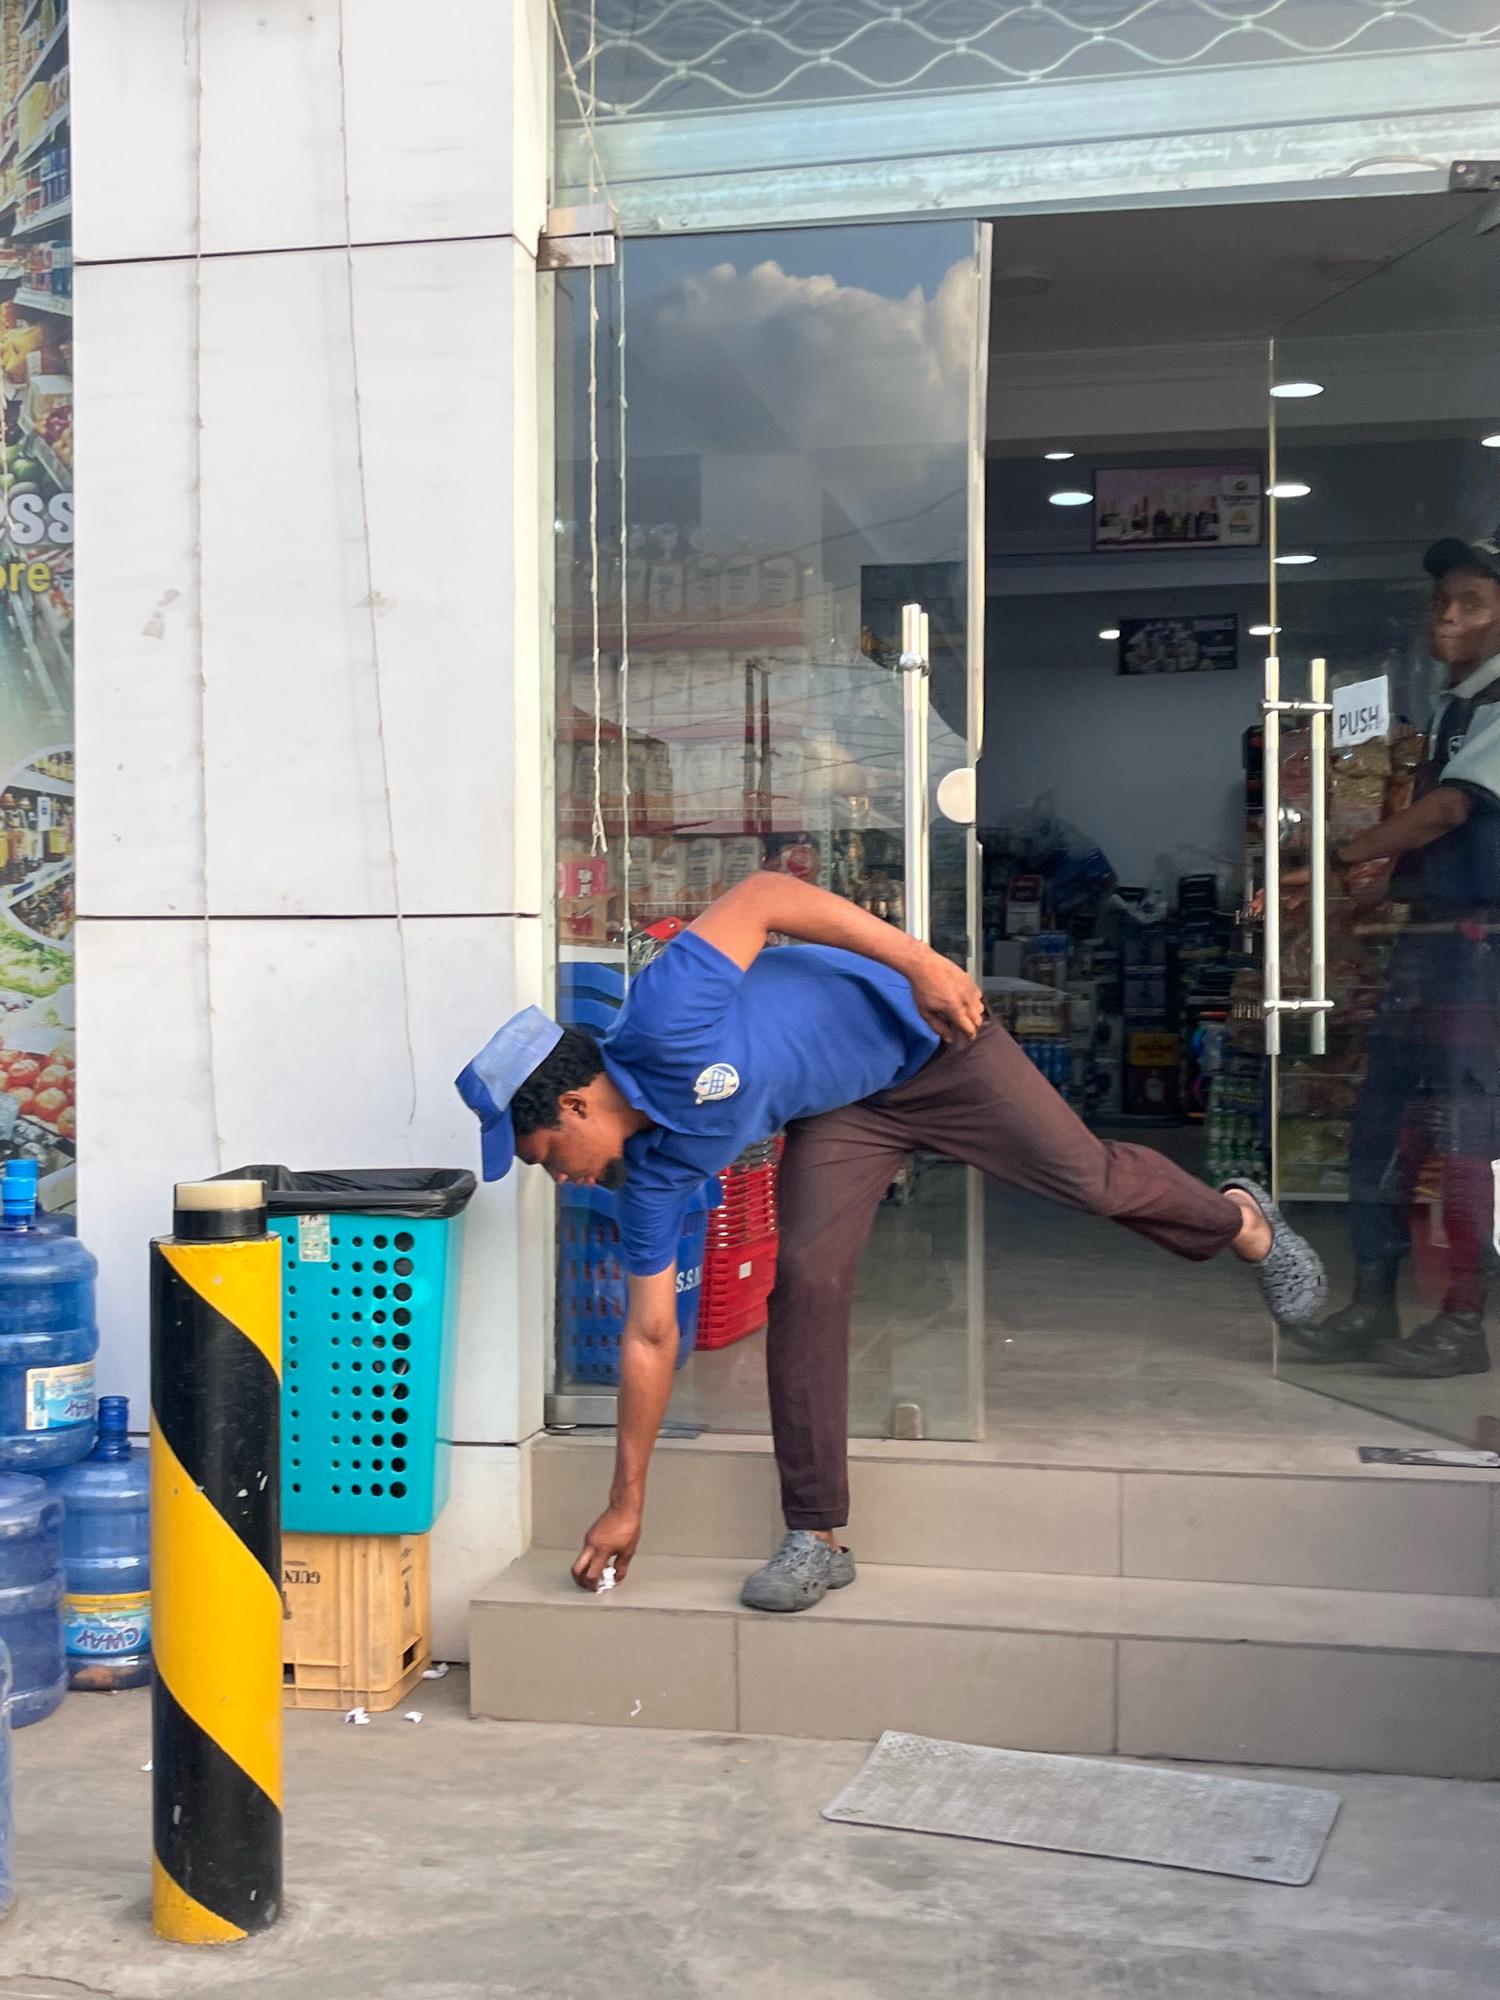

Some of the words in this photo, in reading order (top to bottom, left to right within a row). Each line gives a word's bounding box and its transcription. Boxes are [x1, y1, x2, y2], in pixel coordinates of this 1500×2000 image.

[0, 493, 74, 544] ss
[1339, 705, 1379, 738] PUSH
[76, 1627, 140, 1650] CWAY
